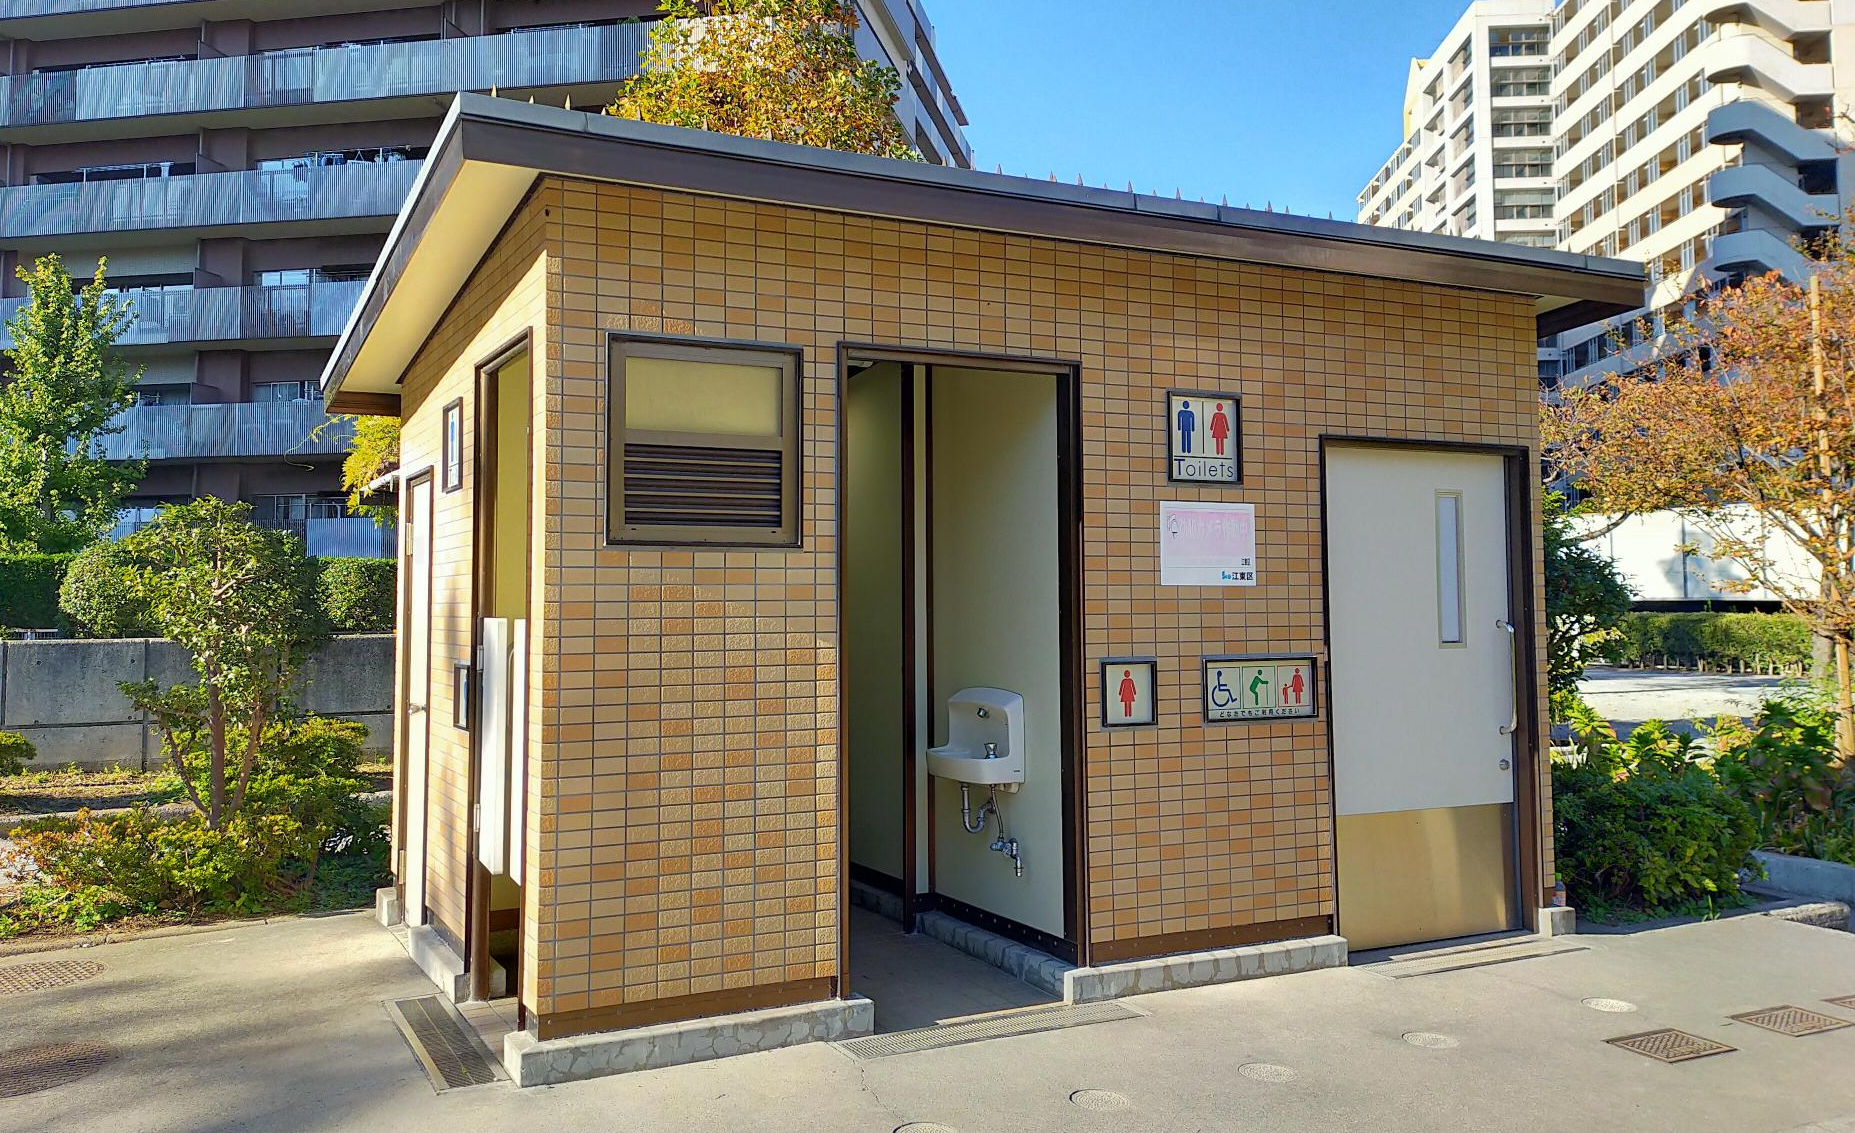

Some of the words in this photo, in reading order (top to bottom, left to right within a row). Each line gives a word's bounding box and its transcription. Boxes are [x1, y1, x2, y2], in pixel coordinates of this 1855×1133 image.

[1174, 458, 1234, 477] Toilets
[1232, 572, 1254, 580] 江東区
